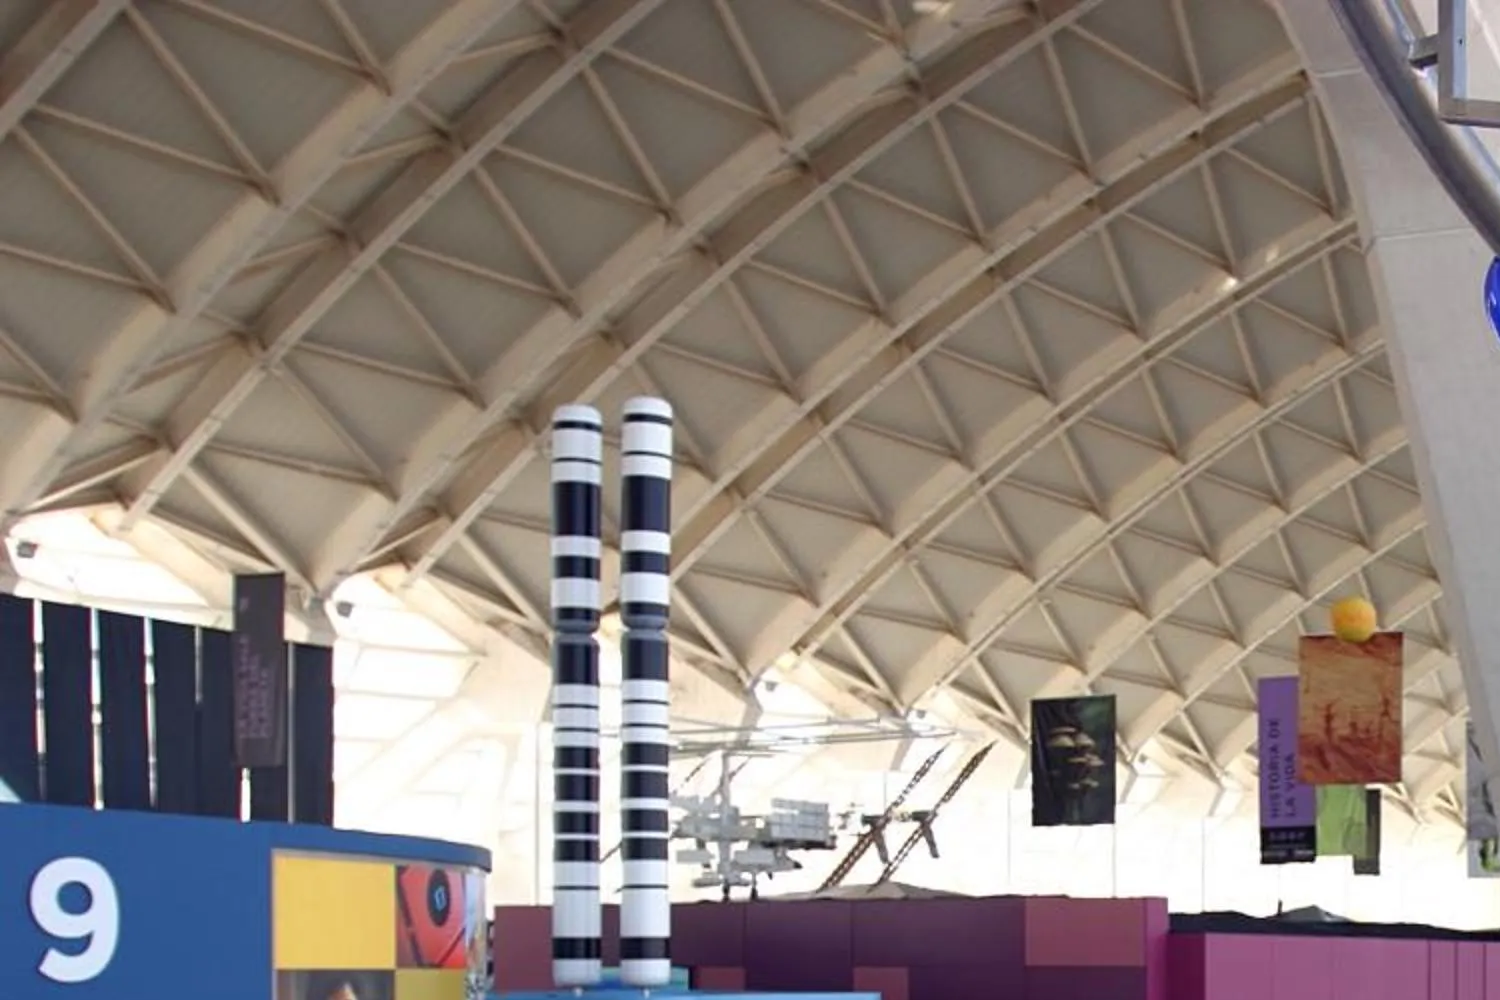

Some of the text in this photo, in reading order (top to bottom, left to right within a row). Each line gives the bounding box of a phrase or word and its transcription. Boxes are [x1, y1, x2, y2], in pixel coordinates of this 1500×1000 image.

[1267, 718, 1281, 819] HISTORIA DE
[1285, 753, 1296, 818] LA VIDA
[30, 856, 119, 982] 9
